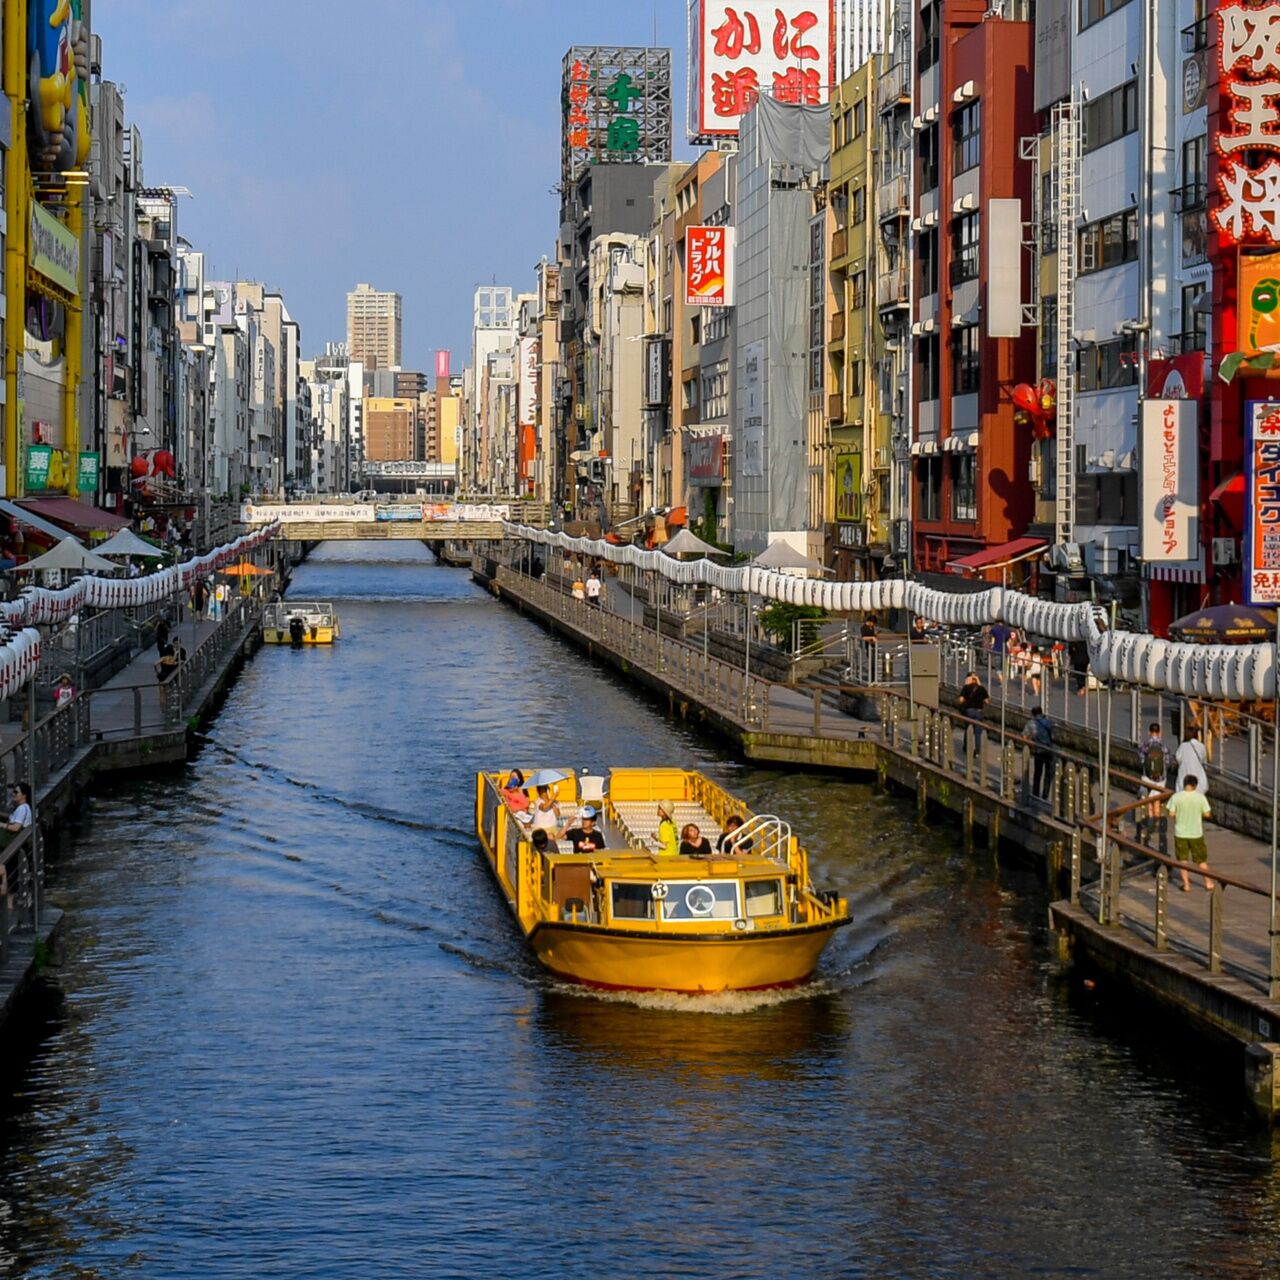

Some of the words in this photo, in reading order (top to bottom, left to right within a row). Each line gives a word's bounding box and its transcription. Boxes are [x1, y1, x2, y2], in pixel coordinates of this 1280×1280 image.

[711, 7, 820, 61] かに
[607, 73, 641, 152] 千房
[690, 238, 705, 286] ドラッグ
[705, 230, 722, 276] ツルハ
